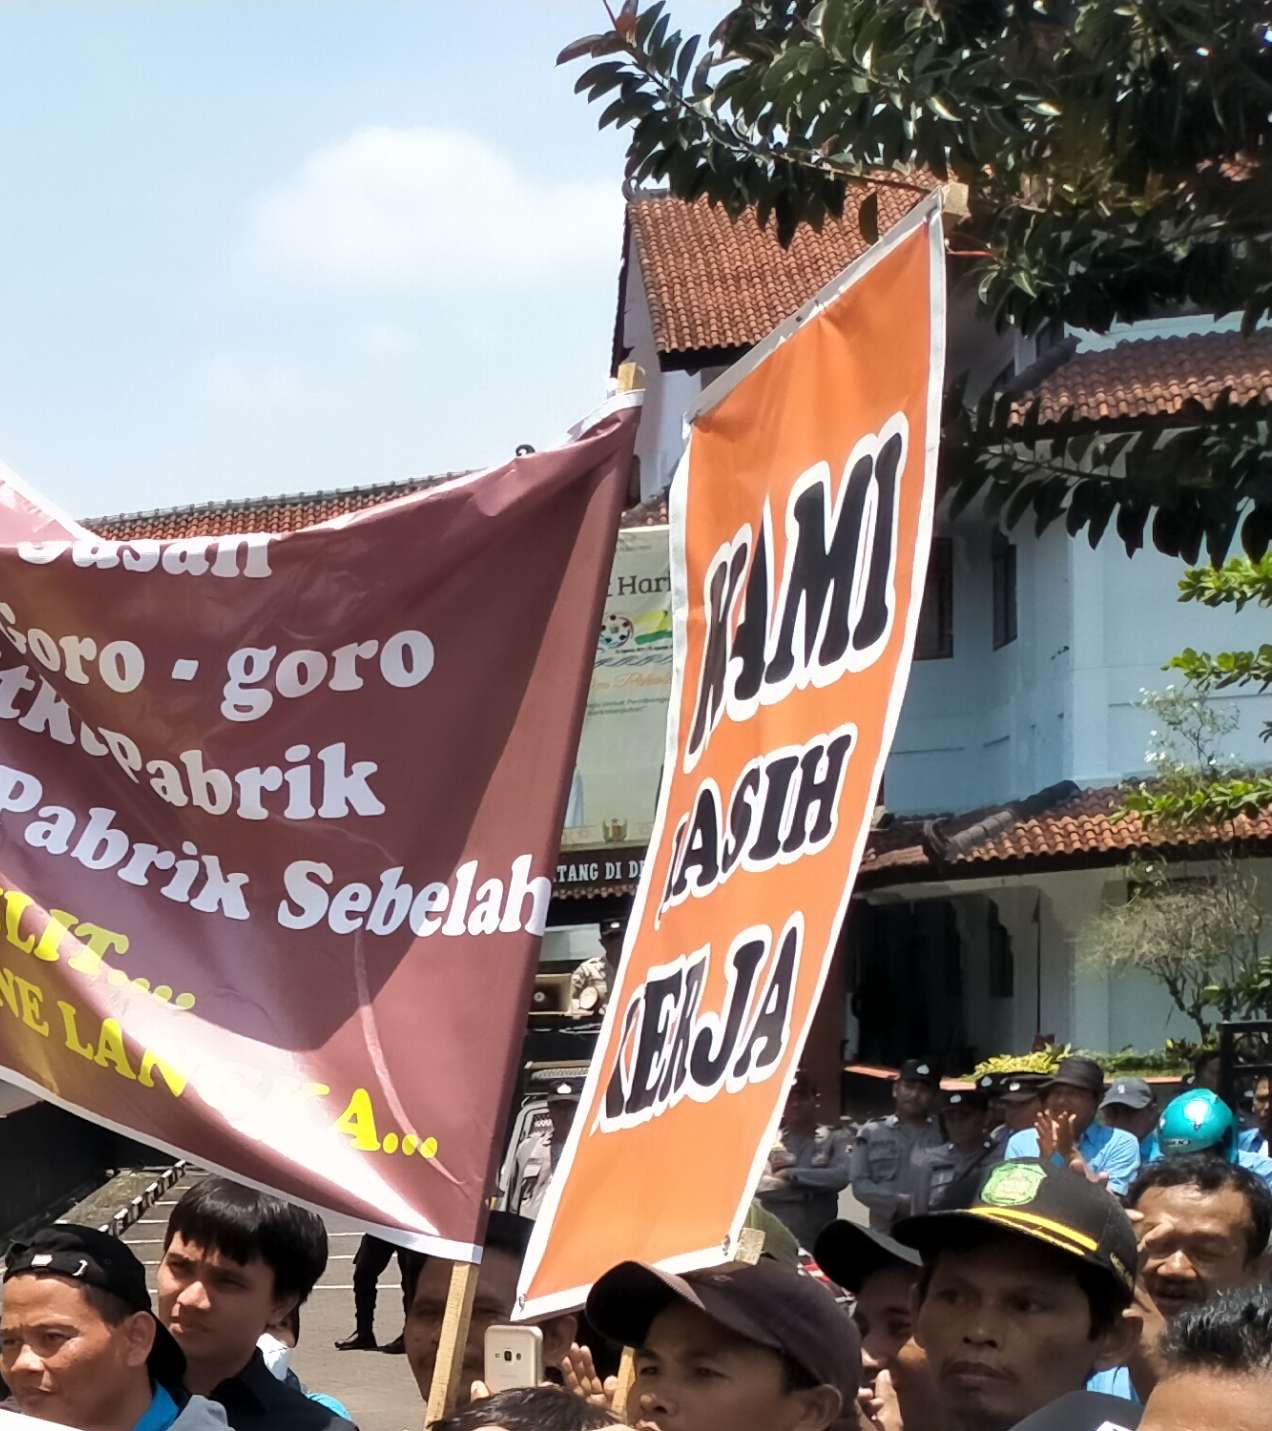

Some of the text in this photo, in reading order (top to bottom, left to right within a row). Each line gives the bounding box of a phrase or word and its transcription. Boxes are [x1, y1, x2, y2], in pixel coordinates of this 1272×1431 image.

[687, 430, 904, 758] KAMI
[220, 629, 436, 722] goro
[97, 726, 387, 822] Pabrik
[658, 733, 853, 910] ASIH
[277, 852, 553, 938] Sebelah
[553, 864, 599, 882] TANG
[605, 861, 623, 880] DI
